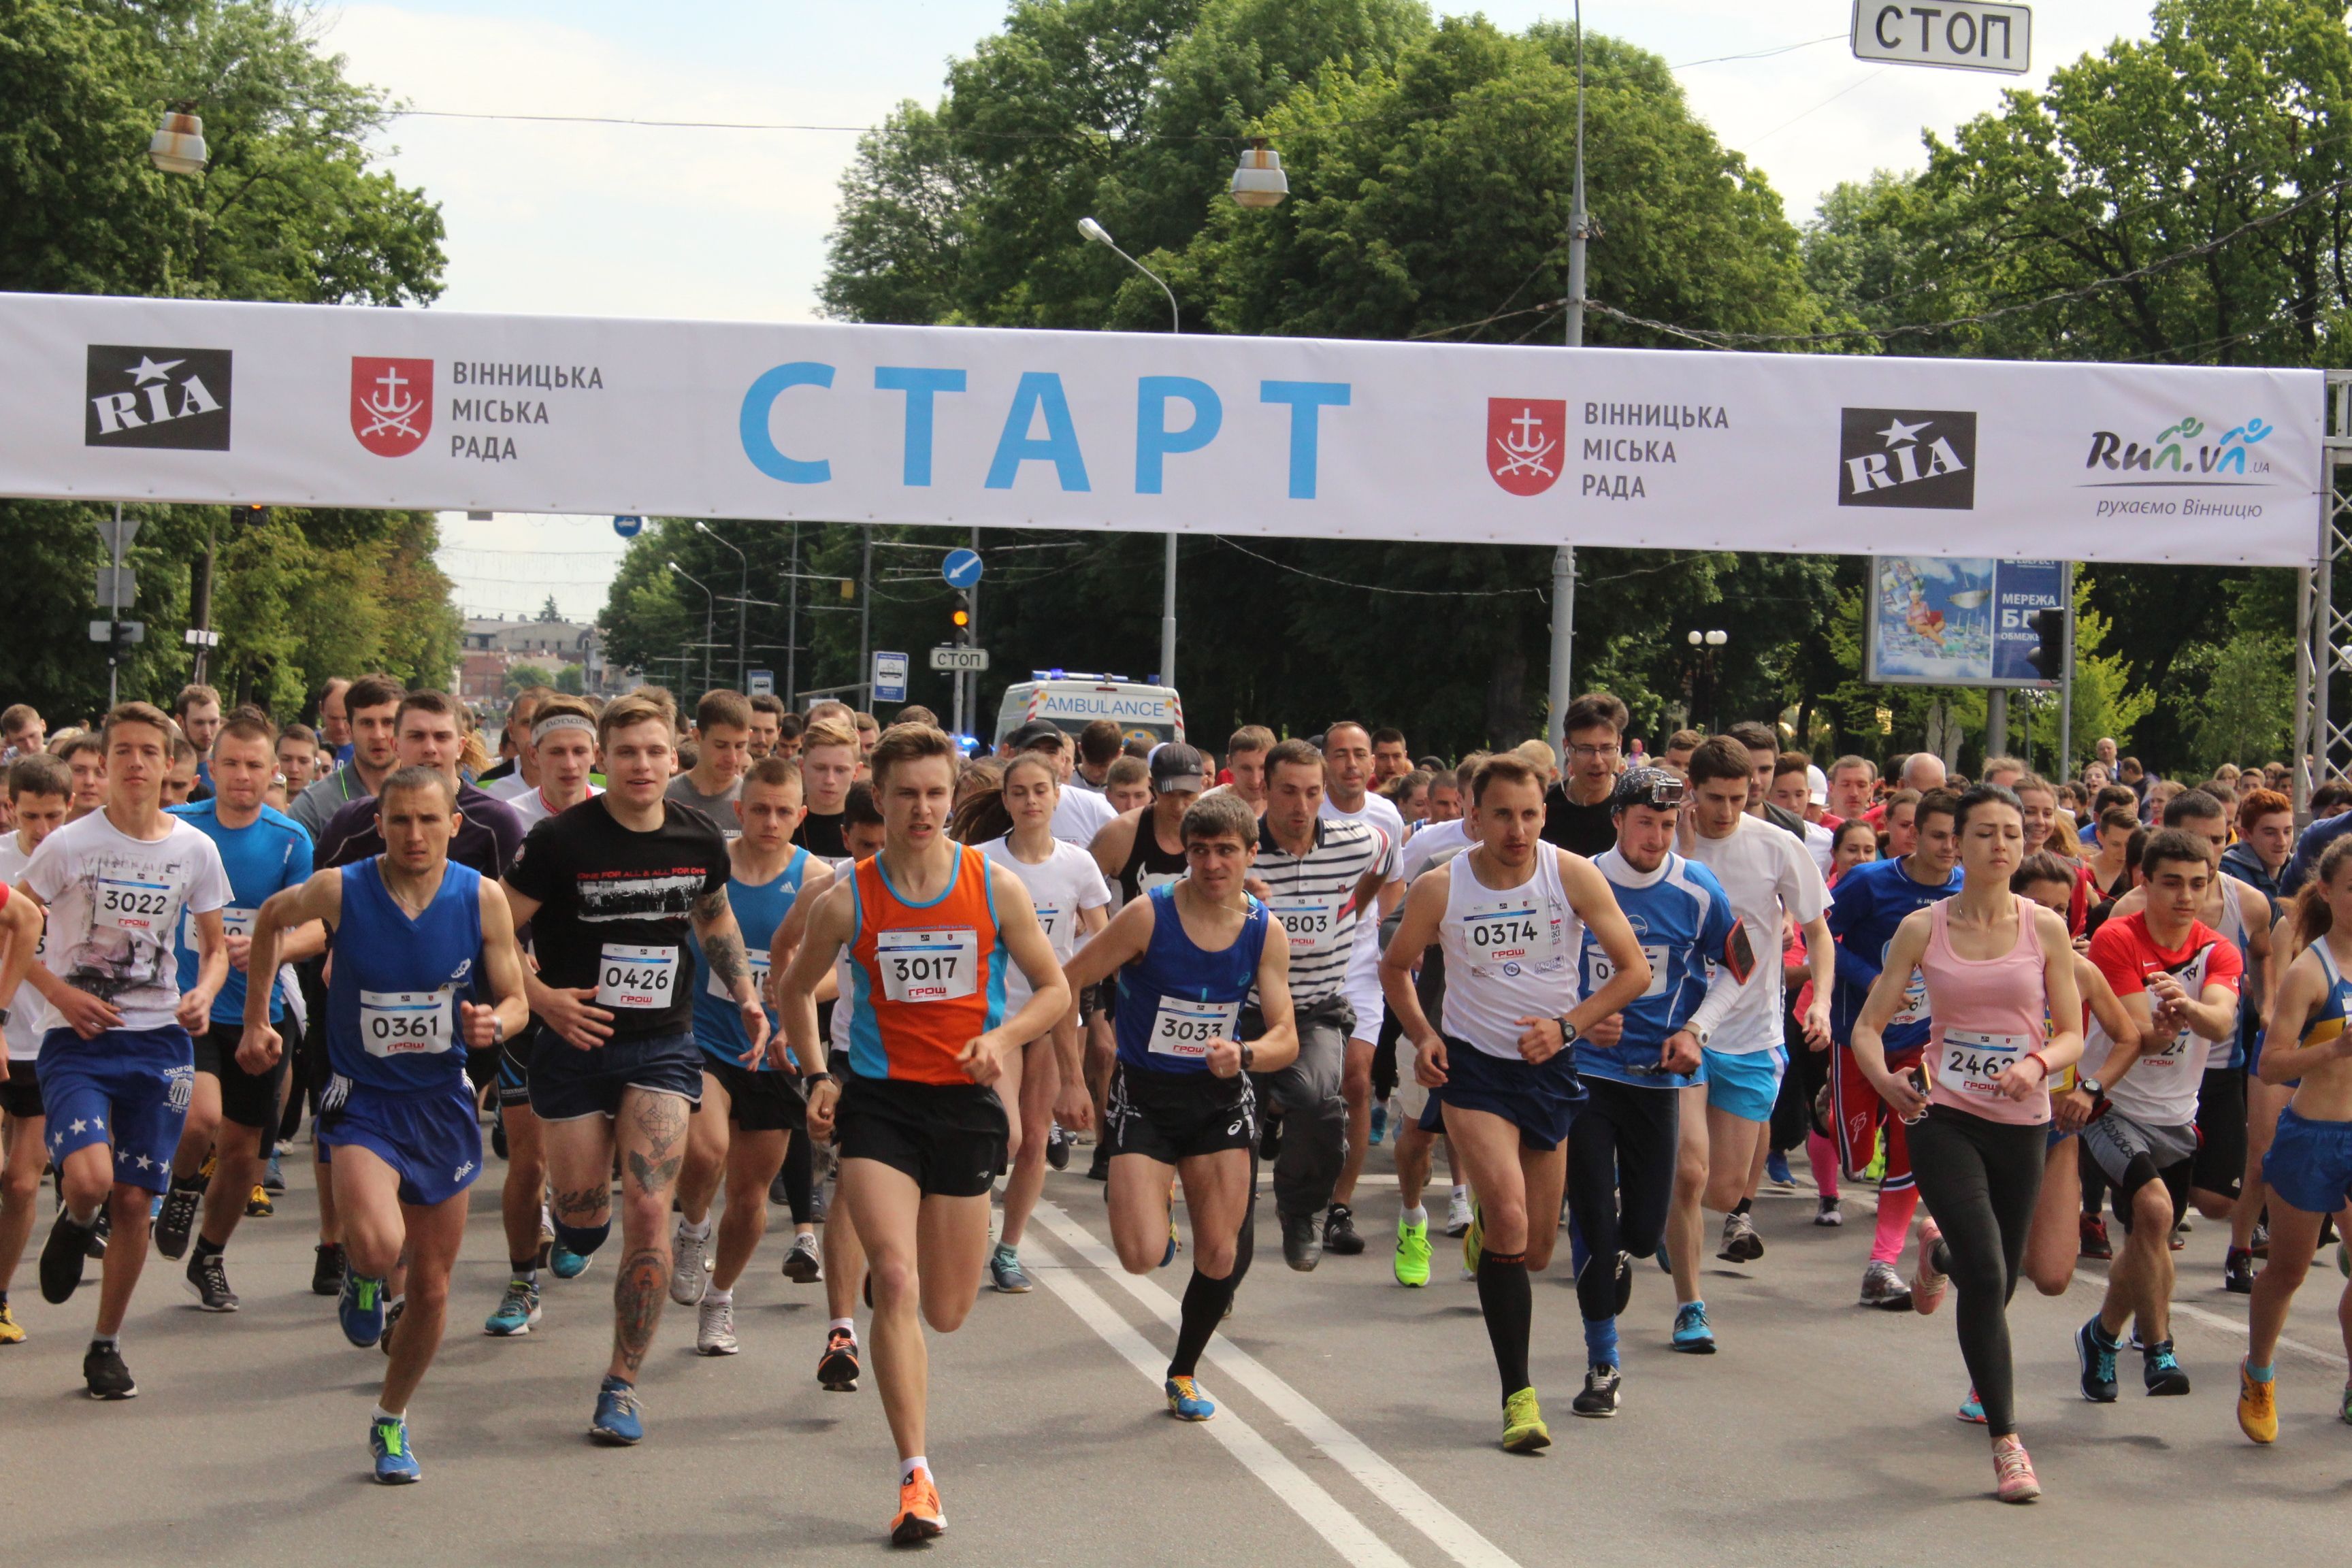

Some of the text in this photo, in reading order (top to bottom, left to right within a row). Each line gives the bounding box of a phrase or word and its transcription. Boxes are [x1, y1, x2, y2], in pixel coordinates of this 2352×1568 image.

[1876, 5, 2011, 60] СТОП
[453, 361, 604, 391] ВІННИЦЬКА
[91, 374, 224, 436] RIA
[452, 399, 550, 425] МІСЬКА
[1585, 402, 1730, 431] ВІННИЦЬКА
[739, 361, 1352, 500] СТАРТ
[451, 435, 518, 463] РАДА
[1584, 438, 1676, 464] МІСЬКА
[1845, 436, 1967, 495] RIA
[1582, 474, 1646, 501] РАДА
[2096, 498, 2263, 519] рухаємо Вінницю
[2002, 593, 2057, 606] МЕРЕЖА
[937, 653, 981, 667] СТОП
[1045, 696, 1165, 717] AMBULANCE
[104, 890, 167, 915] 3022
[118, 918, 150, 927] ГРОШ
[1474, 921, 1538, 946] 0374
[1491, 949, 1525, 958] ГРОШ
[606, 967, 668, 990] 0426
[894, 957, 958, 981] 3017
[908, 987, 947, 996] ГРОШ
[372, 1015, 438, 1039] 0361
[387, 1042, 425, 1051] ГРОШ
[1173, 1045, 1205, 1053] ГРОШ
